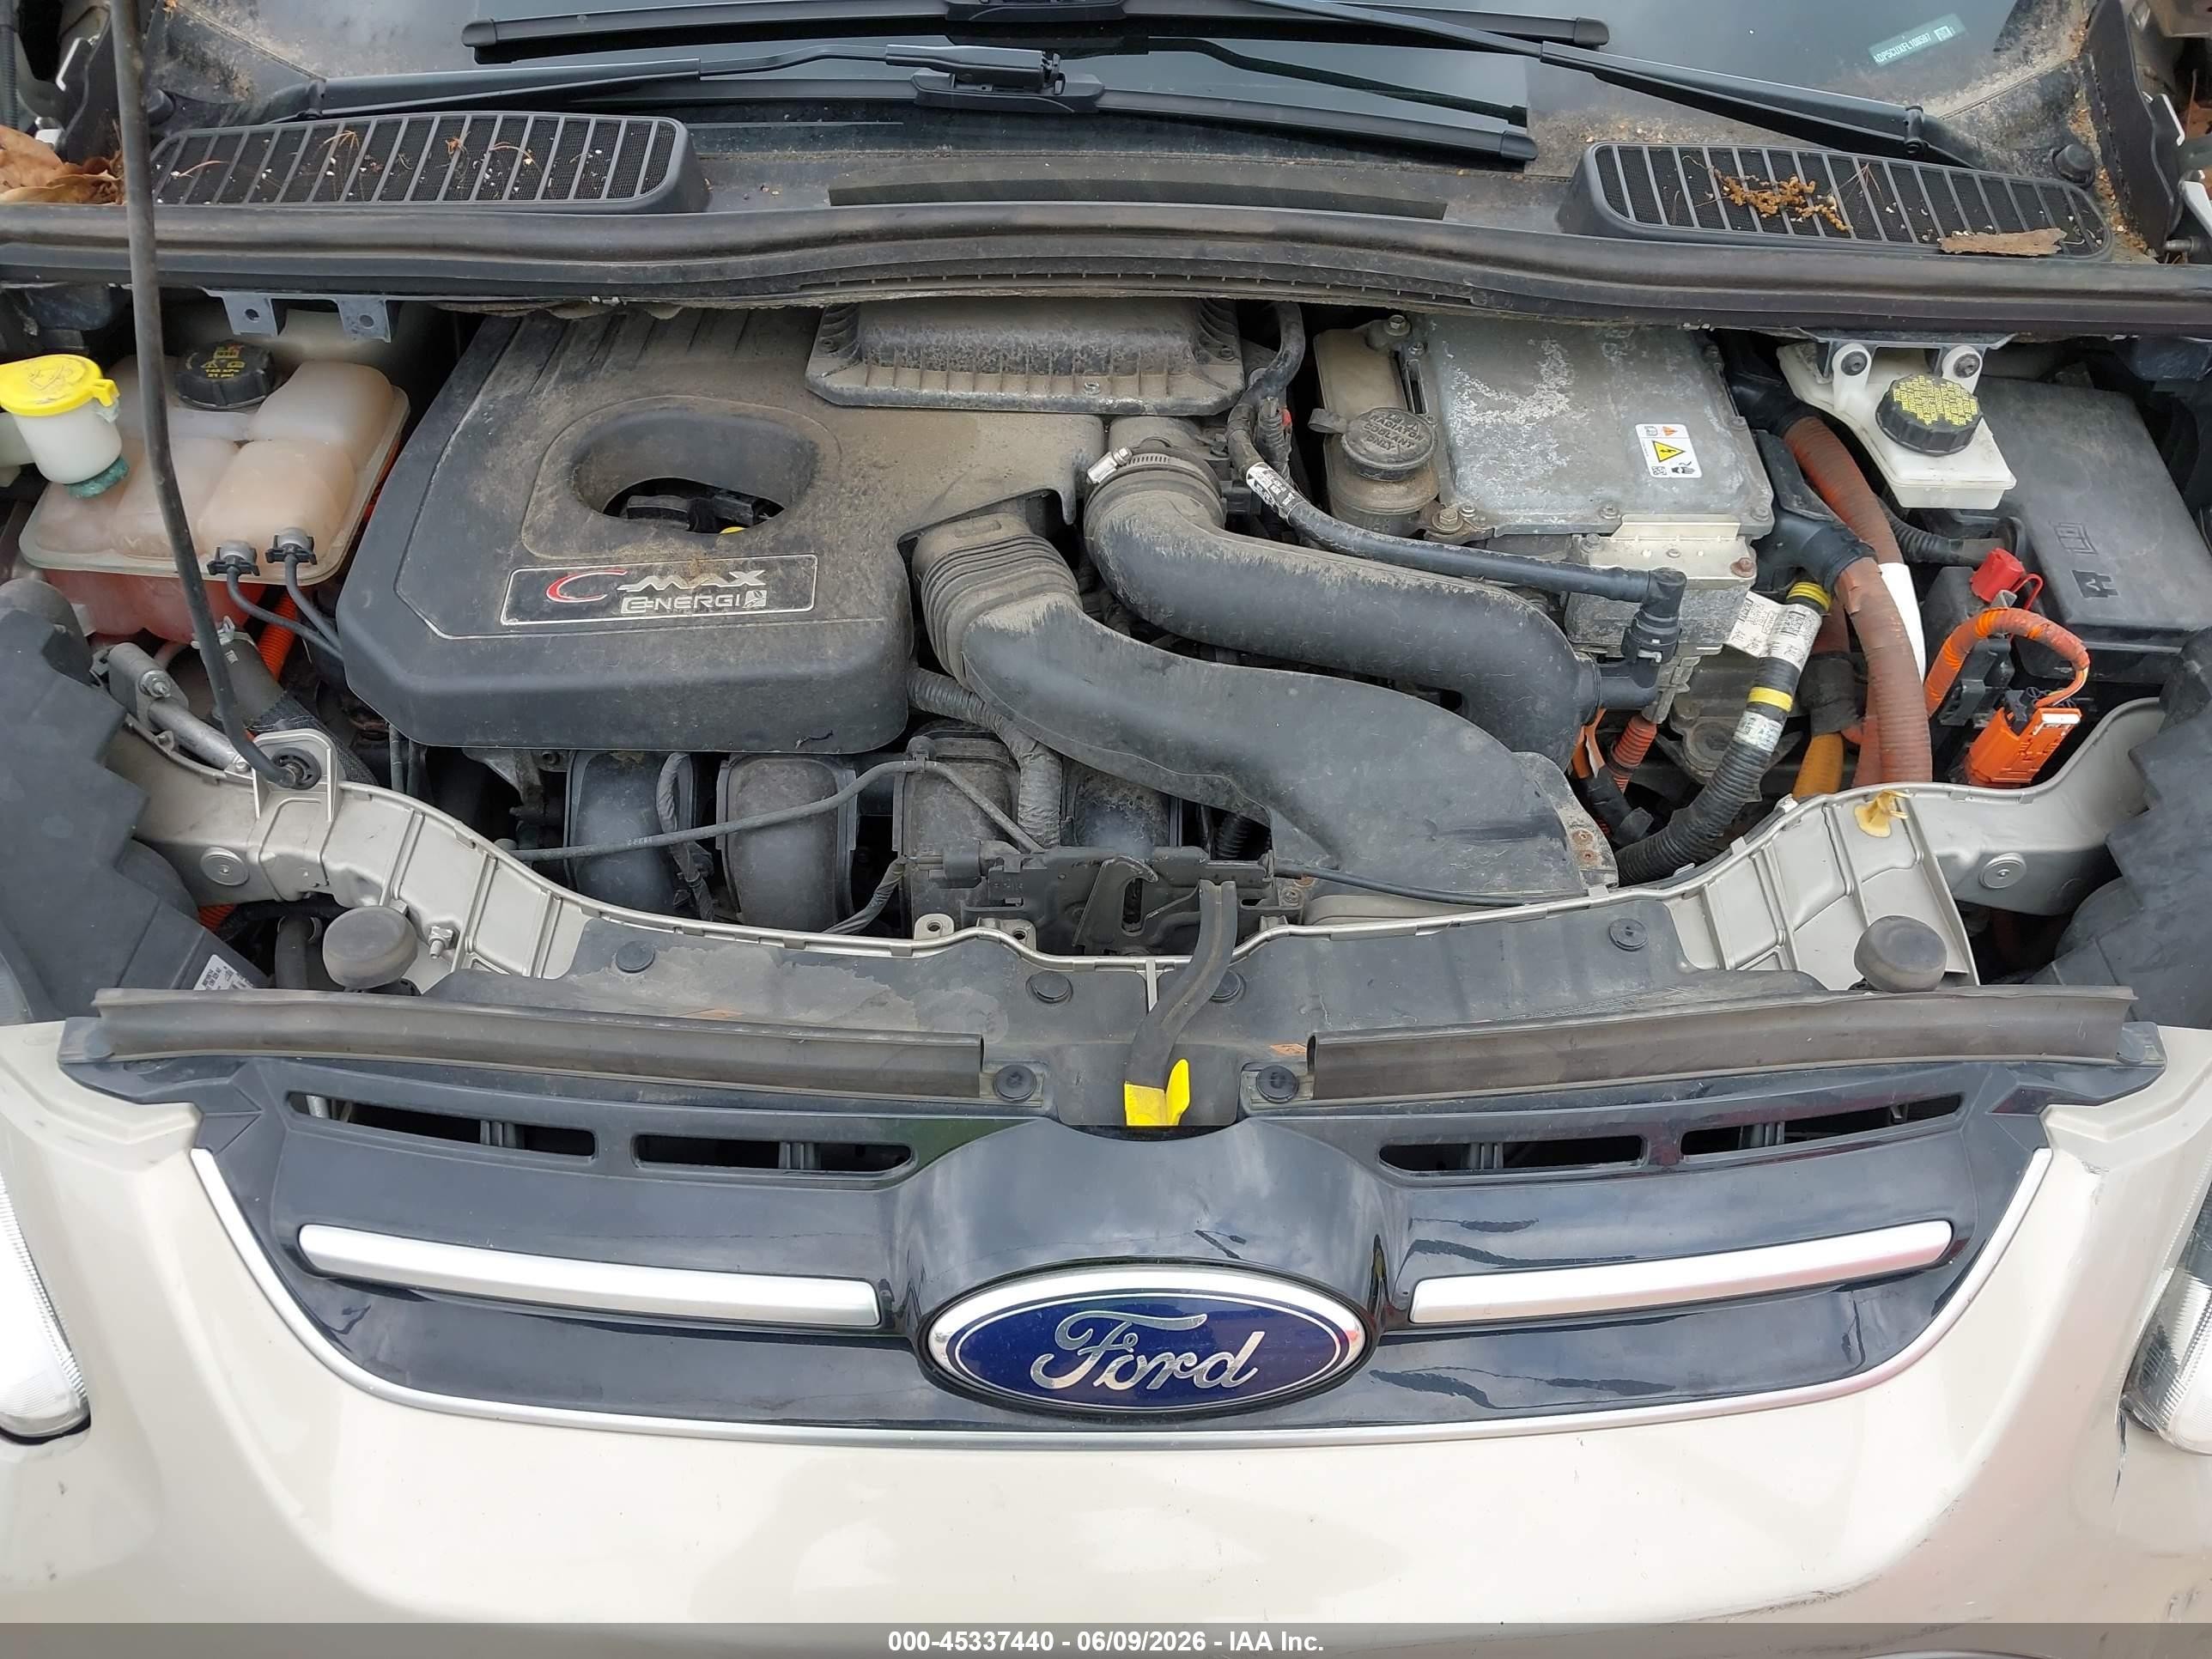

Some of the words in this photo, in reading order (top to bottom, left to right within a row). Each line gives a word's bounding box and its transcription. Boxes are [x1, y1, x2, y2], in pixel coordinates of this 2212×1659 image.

[1364, 423, 1415, 448] COOLANT
[1370, 415, 1425, 441] RADIATOR
[1367, 435, 1397, 451] ONLY
[1030, 1310, 1265, 1390] Ford
